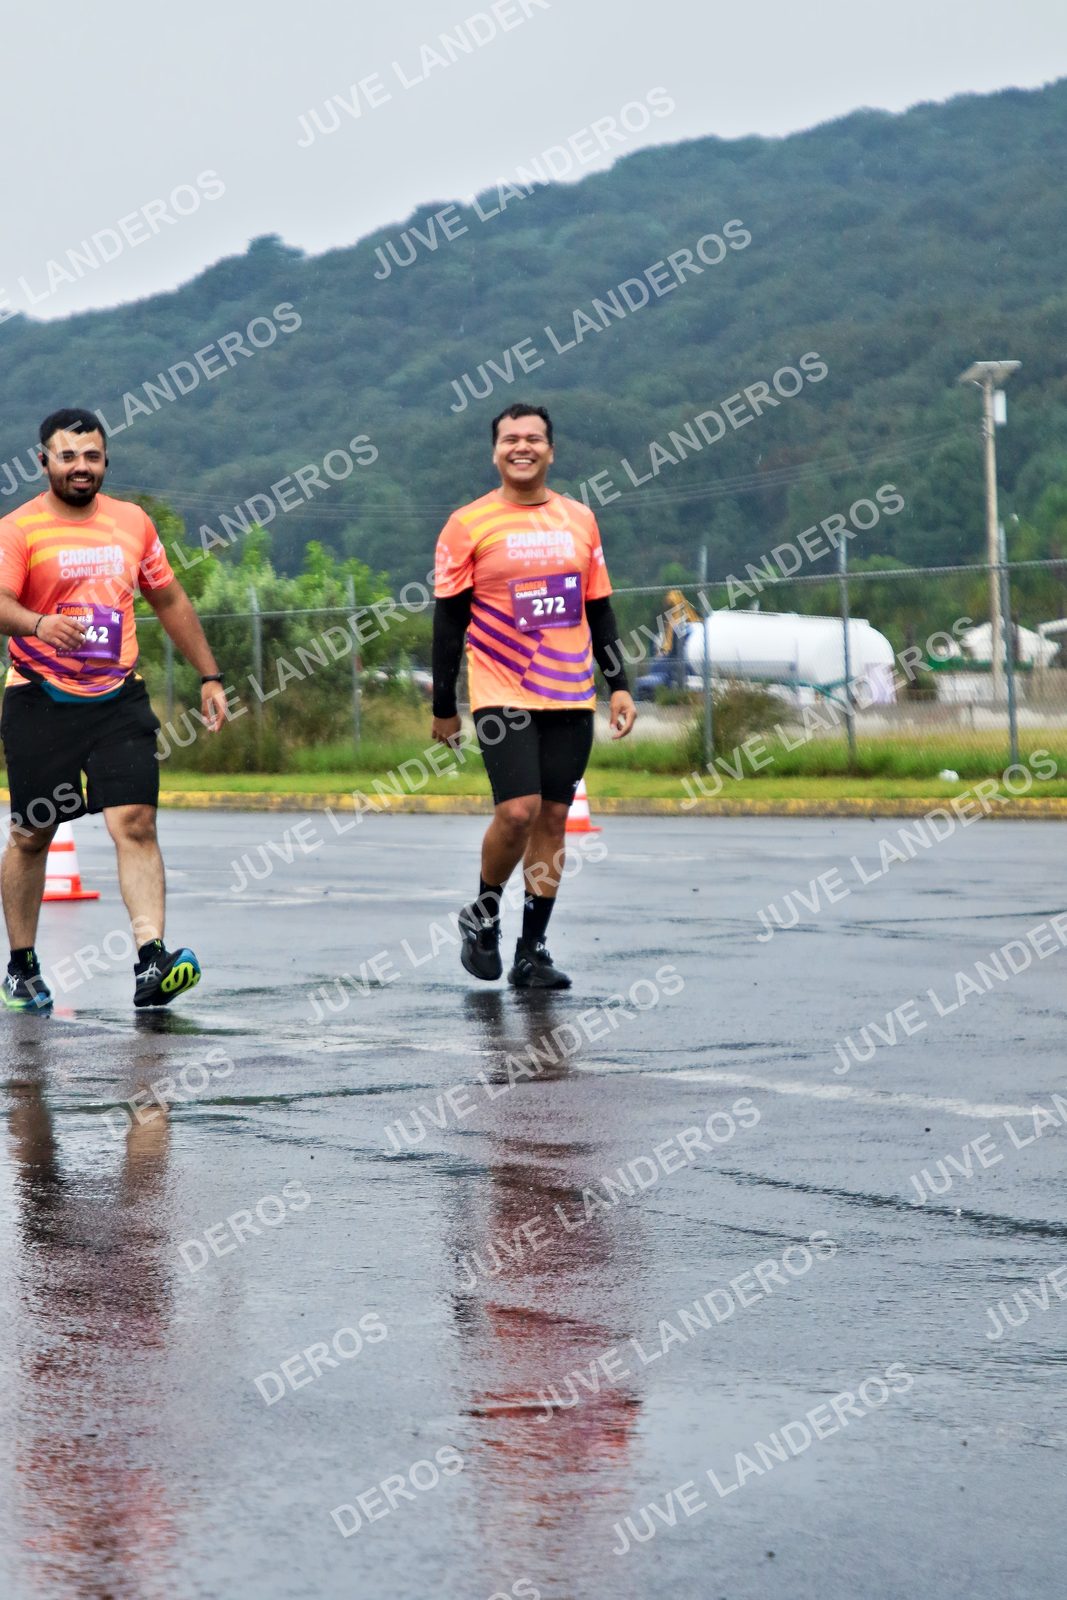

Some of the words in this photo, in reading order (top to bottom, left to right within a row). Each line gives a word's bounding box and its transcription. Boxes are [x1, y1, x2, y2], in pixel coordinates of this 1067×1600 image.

[507, 531, 573, 549] CARRERA
[58, 544, 123, 566] CARRERA
[532, 596, 566, 616] 272
[80, 625, 109, 644] 42
